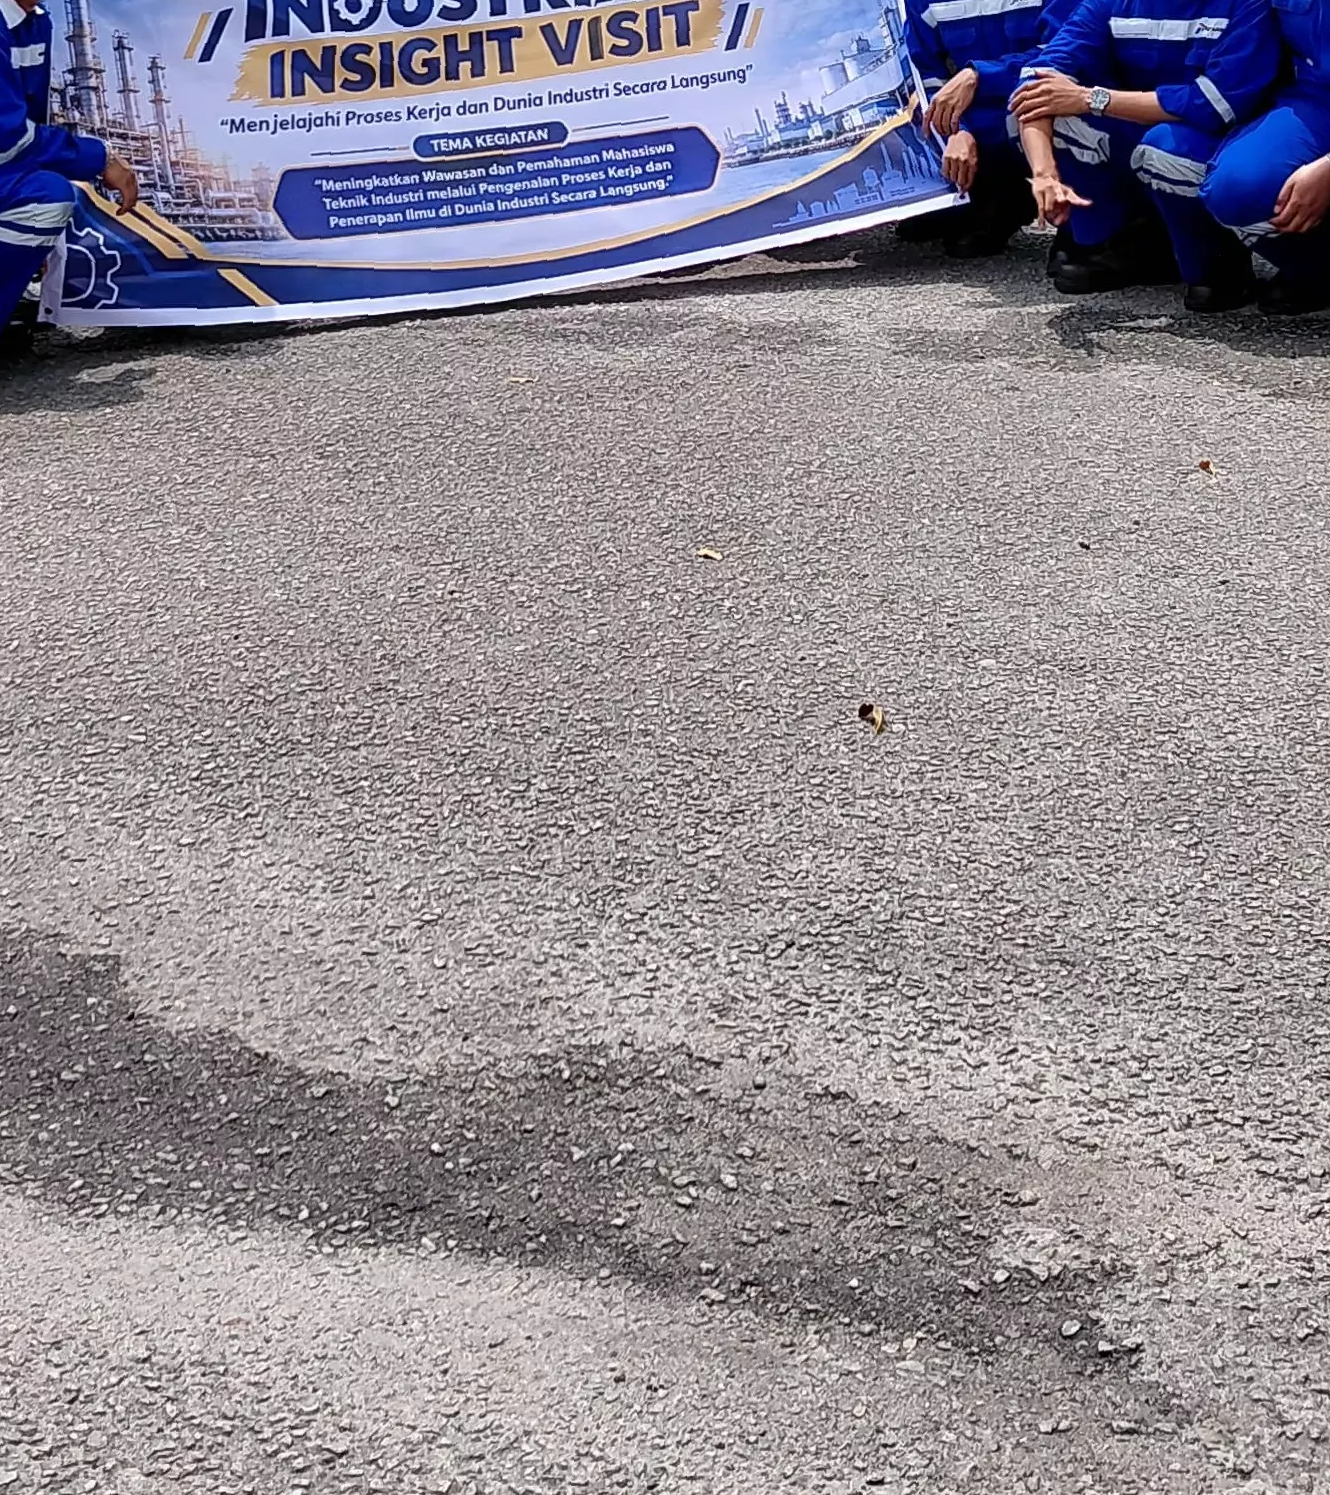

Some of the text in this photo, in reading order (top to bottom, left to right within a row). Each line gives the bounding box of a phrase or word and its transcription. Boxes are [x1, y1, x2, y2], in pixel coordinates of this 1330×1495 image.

[269, 0, 700, 99] INSIGHT VISIT
[345, 109, 402, 126] Proses
[406, 105, 451, 123] Kerja
[456, 100, 489, 116] dan
[494, 92, 543, 111] Dunia
[548, 83, 610, 106] Industri
[613, 79, 667, 97] Secara
[430, 127, 549, 153] TEMA KEGIATAN
[323, 159, 671, 211] Teknik Industri melalui Pengenalan Proses Kerja dan
[422, 166, 486, 183] Wawasan
[489, 162, 515, 177] dan
[518, 153, 600, 173] Pemahaman
[602, 143, 675, 161] Mahasiswa
[329, 211, 403, 229] Penerapan
[406, 207, 436, 222] Ilmu
[439, 203, 452, 218] di
[455, 200, 494, 216] Dunia
[498, 191, 549, 210] Industri
[552, 186, 597, 203] Secara
